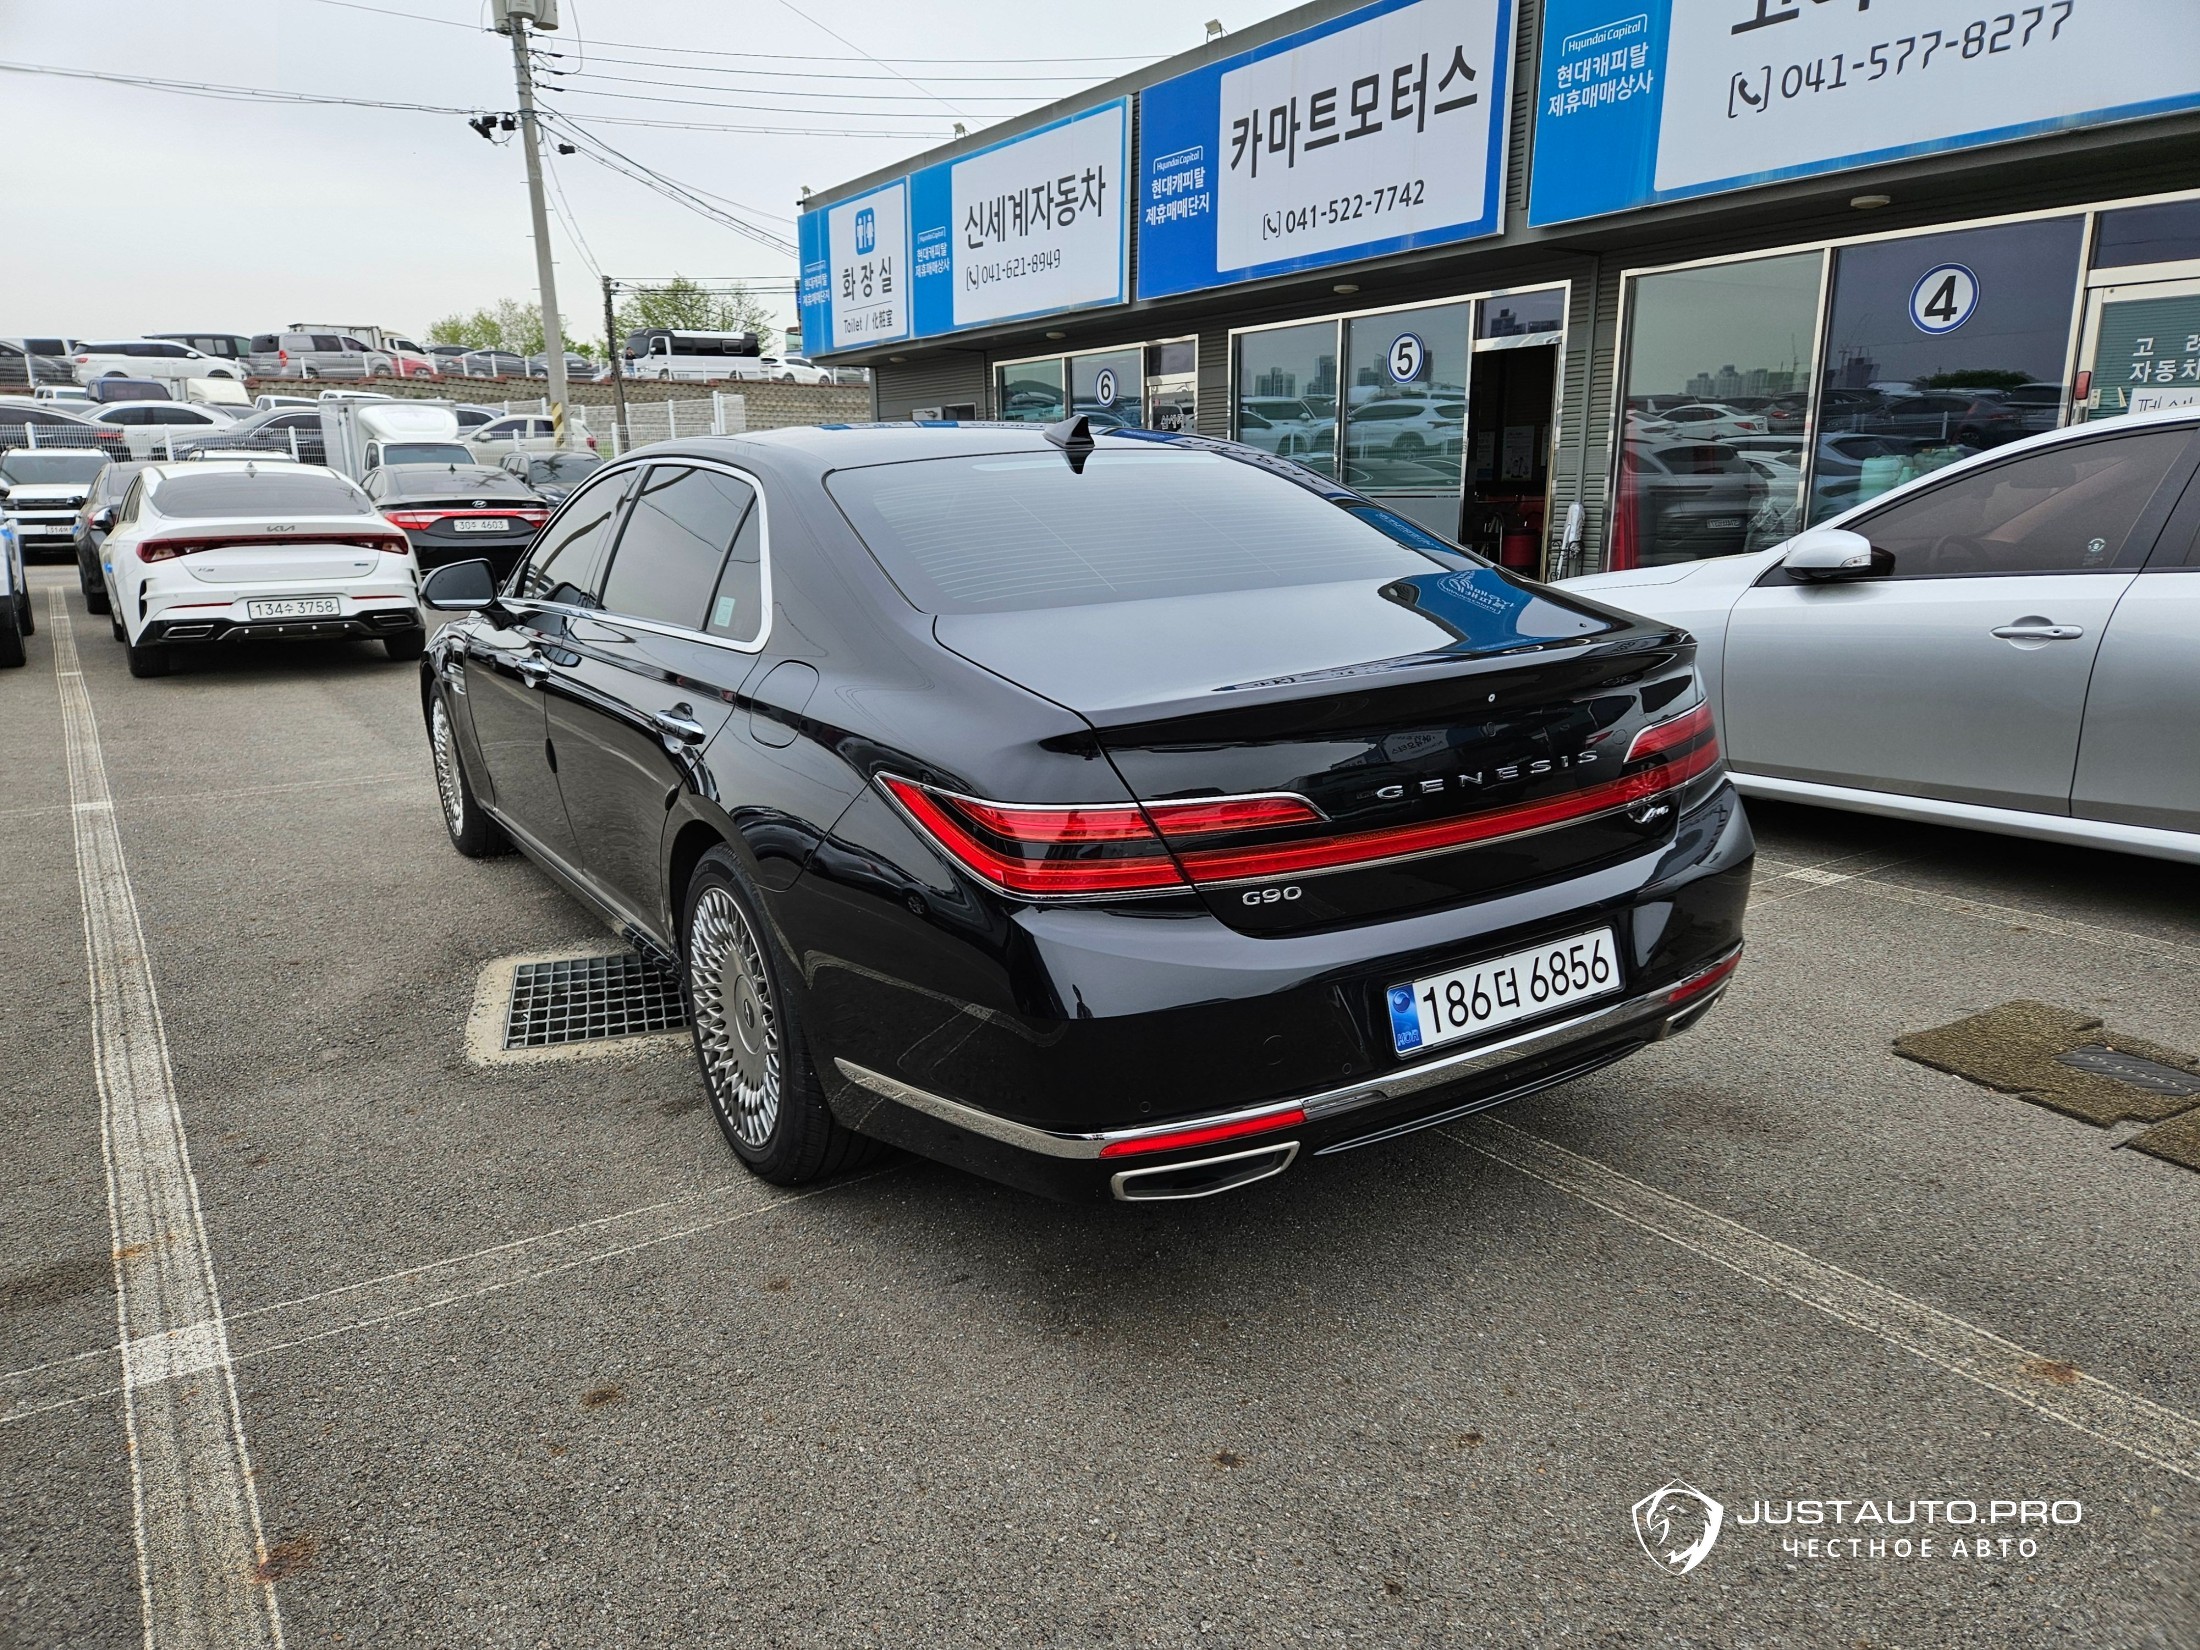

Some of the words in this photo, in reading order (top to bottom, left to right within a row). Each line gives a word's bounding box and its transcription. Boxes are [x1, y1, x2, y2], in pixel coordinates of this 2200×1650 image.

[1568, 31, 1606, 52] Hyundai
[1607, 20, 1641, 40] Capital
[1781, 0, 2074, 98] 041-577-8277
[1557, 42, 1649, 89] 현대캐피탈
[1230, 44, 1478, 178] 카마트모터스
[1547, 69, 1654, 117] 제휴매매상사
[1151, 166, 1206, 199] 현대캐피탈
[964, 165, 1106, 249] 신세계자동차
[1145, 192, 1210, 226] 제휴매매단지
[1285, 179, 1425, 234] 041-522-7742
[842, 256, 893, 301] 화장실
[981, 249, 1061, 284] 041-621-8949
[1924, 276, 1957, 322] 4
[843, 317, 863, 334] Toilet
[1396, 342, 1413, 375] 5
[1101, 374, 1111, 401] 6
[297, 601, 335, 614] 3758
[1376, 750, 1598, 800] GENESIS
[1242, 886, 1302, 906] G90
[1423, 966, 1521, 1034] 186더
[1530, 939, 1610, 1003] 6856
[1396, 1030, 1420, 1047] KOR
